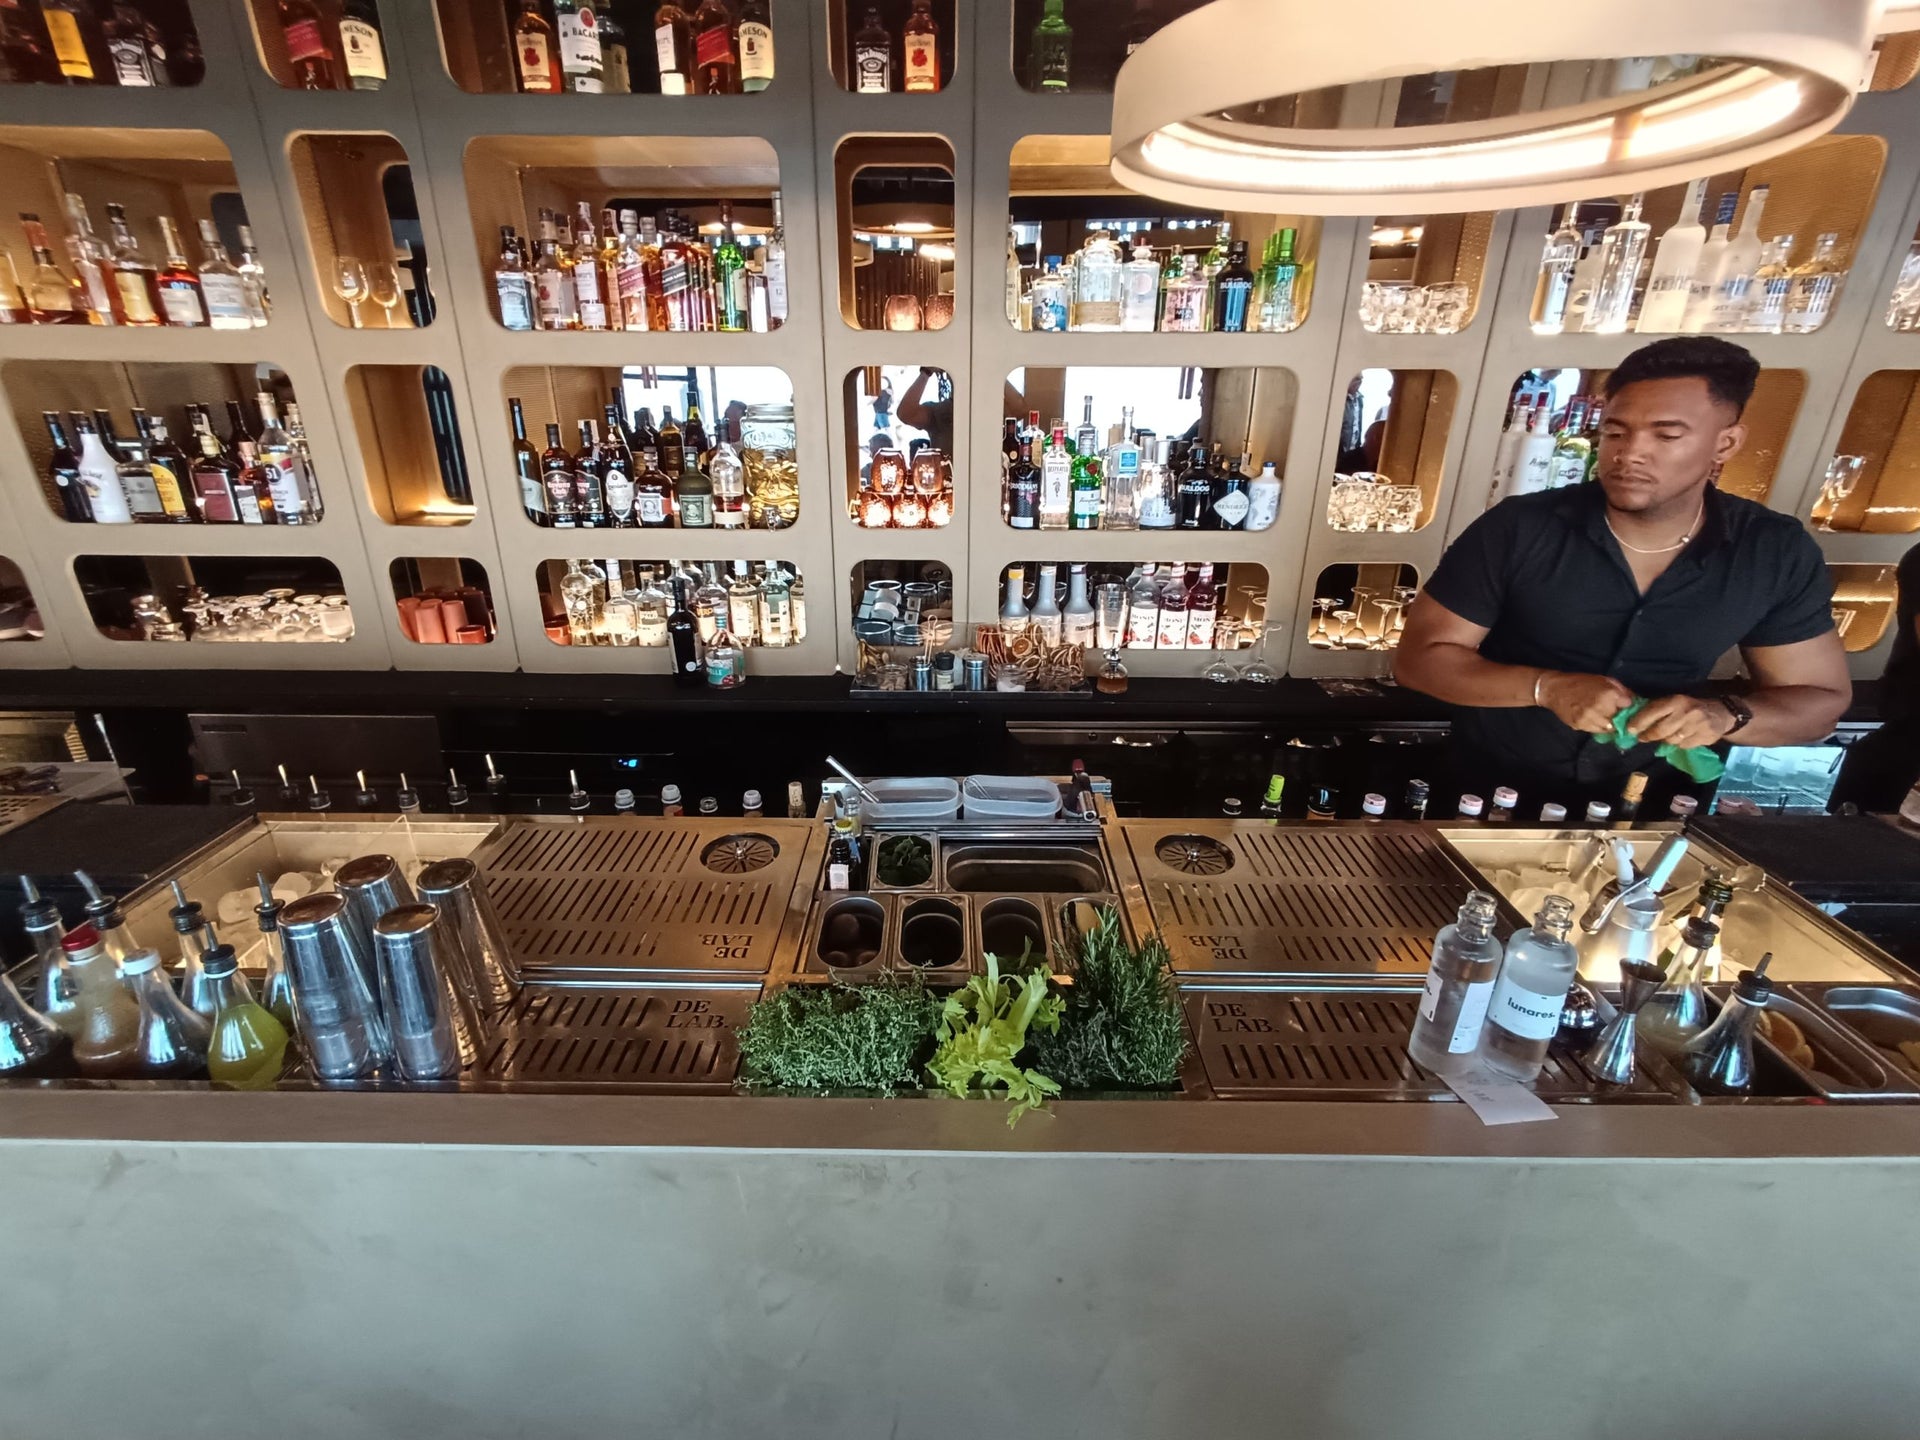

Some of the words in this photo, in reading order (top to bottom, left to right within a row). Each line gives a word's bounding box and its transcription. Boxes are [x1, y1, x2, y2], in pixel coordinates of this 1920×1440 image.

[264, 467, 278, 480] 51
[672, 999, 712, 1014] DE
[1207, 1002, 1247, 1018] DE
[665, 1014, 729, 1029] LAB.
[1212, 1018, 1280, 1033] LAB.
